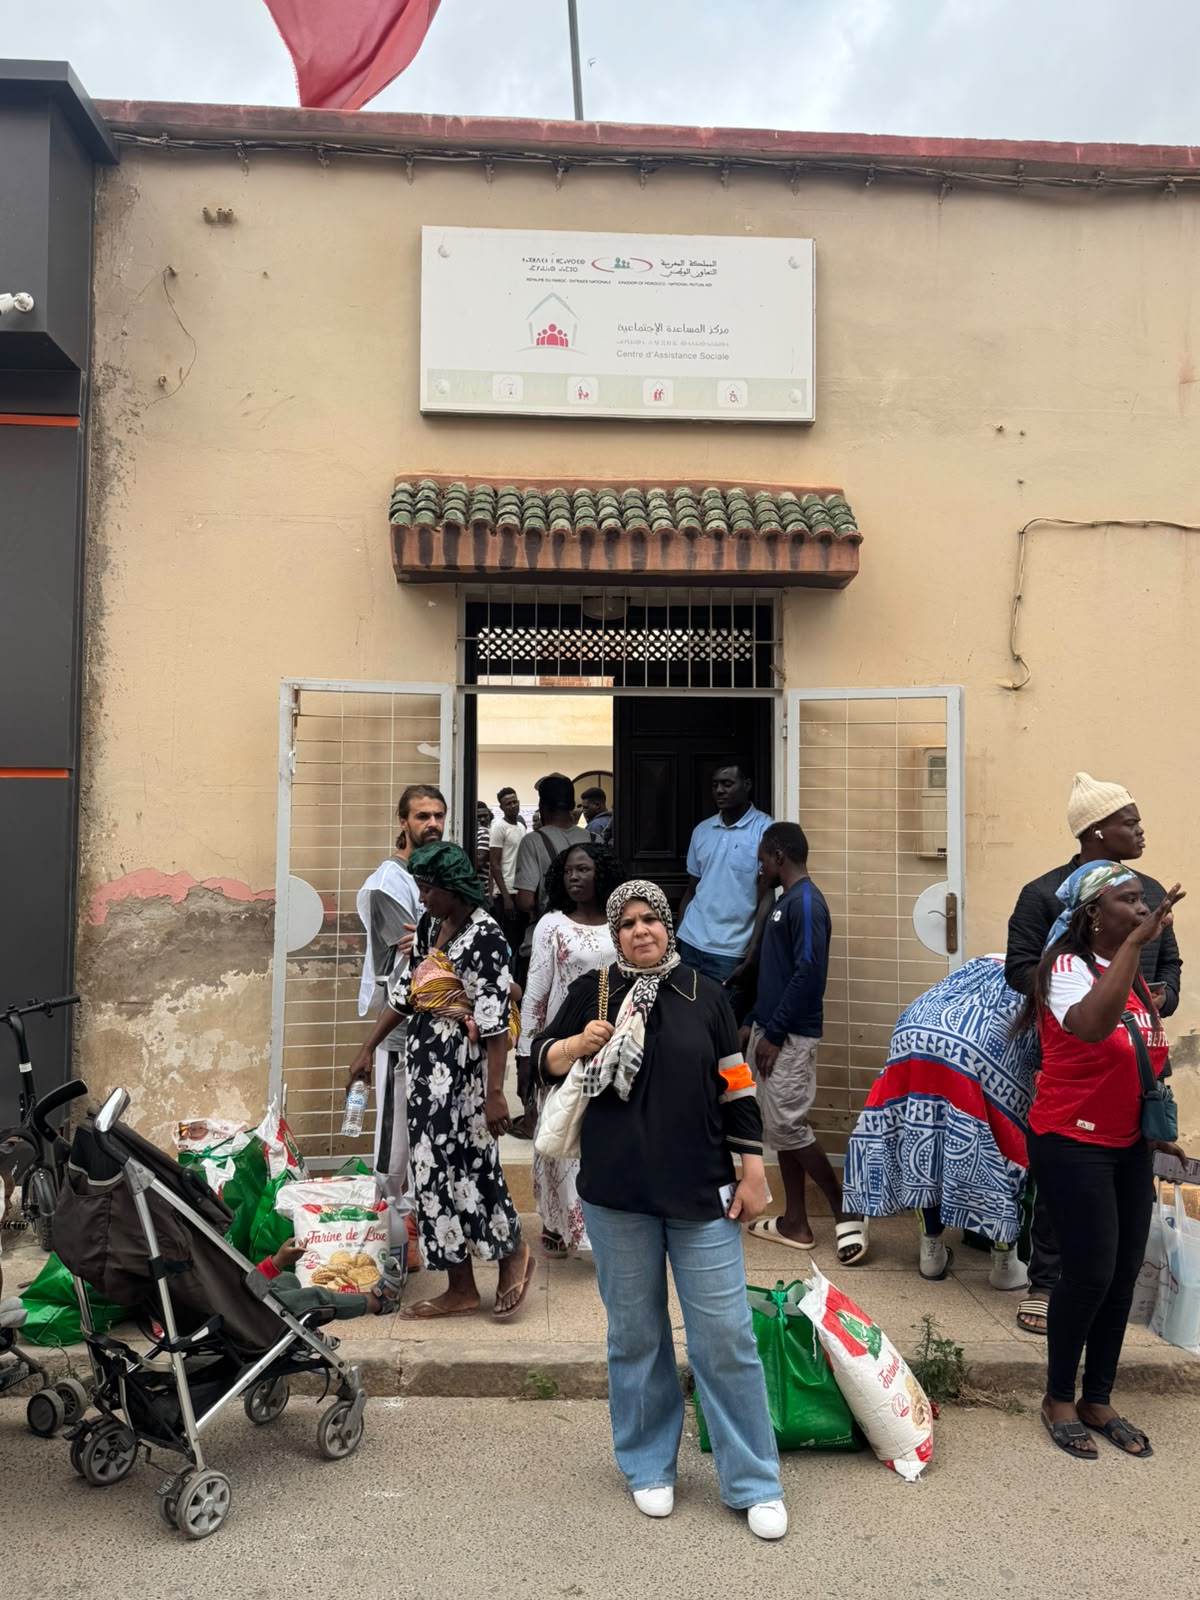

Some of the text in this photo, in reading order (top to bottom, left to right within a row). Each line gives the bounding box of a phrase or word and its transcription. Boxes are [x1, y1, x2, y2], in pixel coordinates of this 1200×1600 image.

[661, 259, 685, 269] المغربية
[666, 323, 706, 334] المساعدة
[709, 324, 730, 336] مركز
[616, 349, 730, 361] Centre d'Assistance Sociale
[307, 1225, 387, 1245] Farine de Luxe
